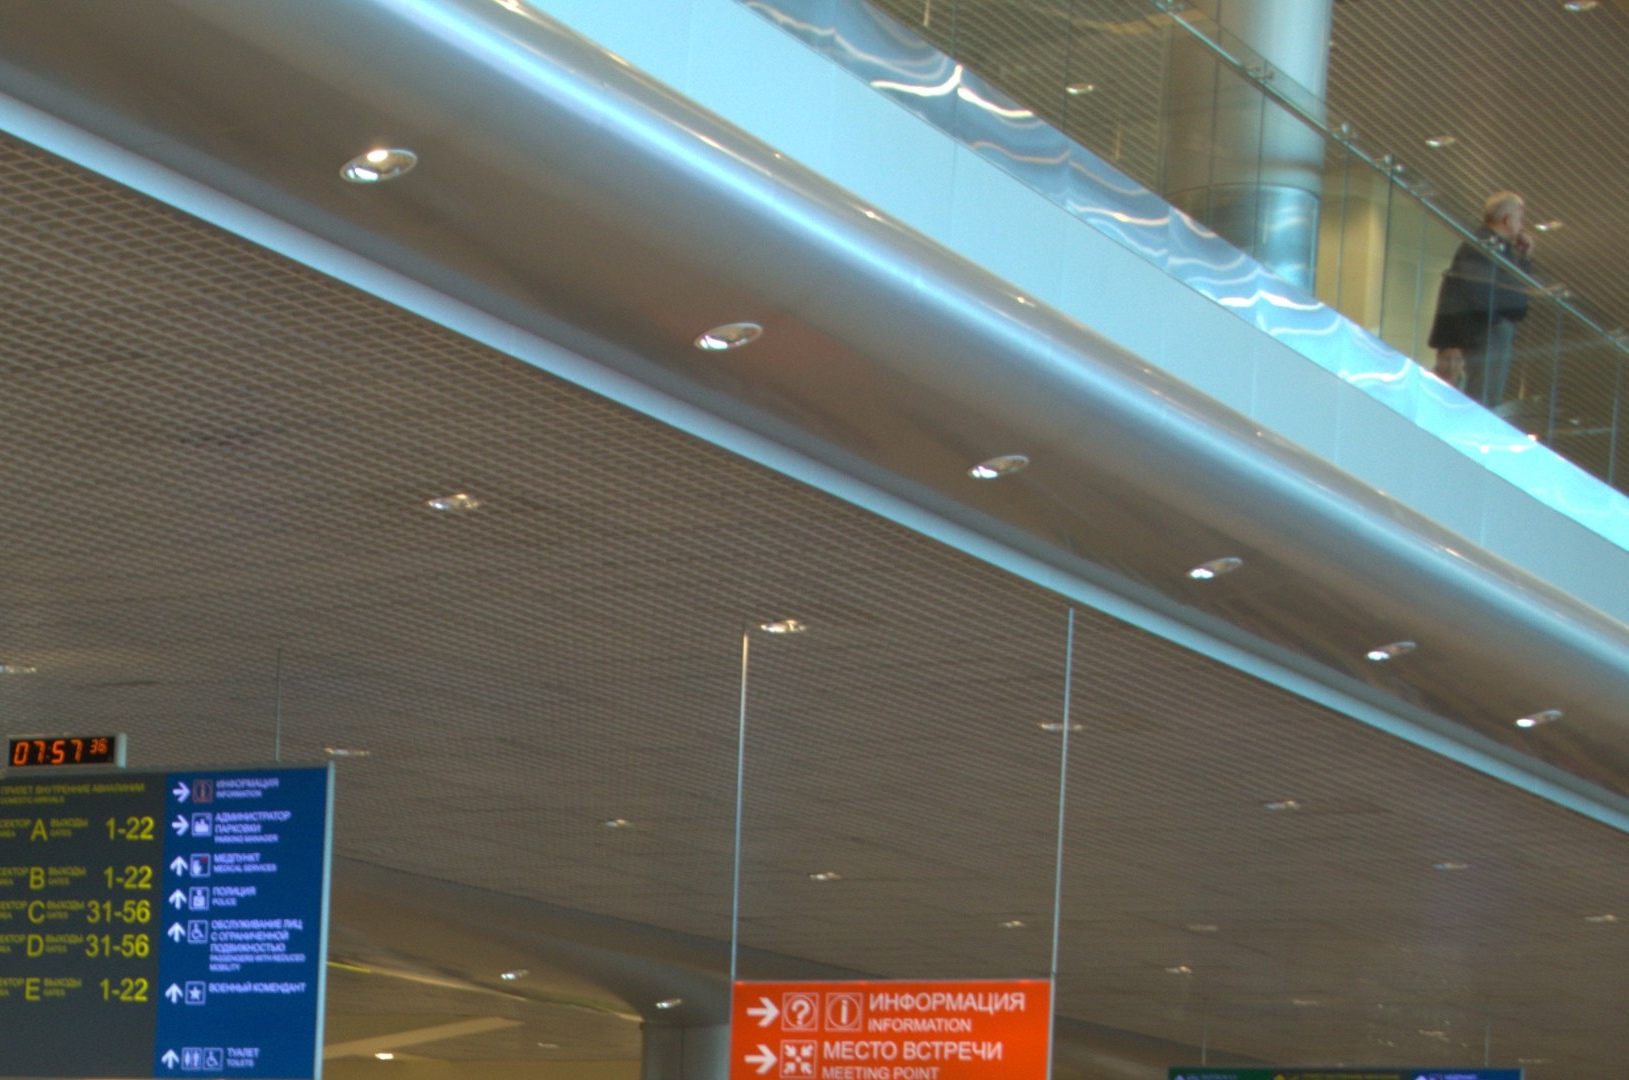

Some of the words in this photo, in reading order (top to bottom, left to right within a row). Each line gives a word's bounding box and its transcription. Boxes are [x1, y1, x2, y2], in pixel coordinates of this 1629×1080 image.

[13, 740, 83, 766] 07:57
[215, 778, 279, 789] ИНФОРМАЦИЯ
[215, 790, 262, 798] INFORMATION
[215, 811, 291, 822] АДМИНИСТРАТОР
[31, 818, 48, 840] A
[105, 817, 154, 840] 1-22
[215, 824, 261, 833] ПАРКОВКИ
[213, 853, 261, 864] МЕДПУНКТ
[29, 867, 45, 889] B
[104, 866, 153, 889] 1-22
[212, 886, 257, 896] ПОЛИЦИЯ
[28, 900, 45, 923] C
[87, 900, 151, 923] 31-56
[27, 934, 43, 956] D
[85, 934, 149, 957] 31-56
[25, 978, 40, 1000] E
[100, 978, 148, 1002] 1-22
[209, 982, 253, 992] ВОЕННЫЙ
[253, 982, 307, 994] КОМЕНДАНТ
[869, 992, 1025, 1015] ИНФОРМАЦИЯ
[868, 1018, 971, 1032] INFORMATION
[823, 1041, 897, 1060] МЕСТО
[903, 1040, 1003, 1061] ВСТРЕЧИ
[822, 1066, 889, 1080] MEETING
[893, 1066, 939, 1080] POINT
